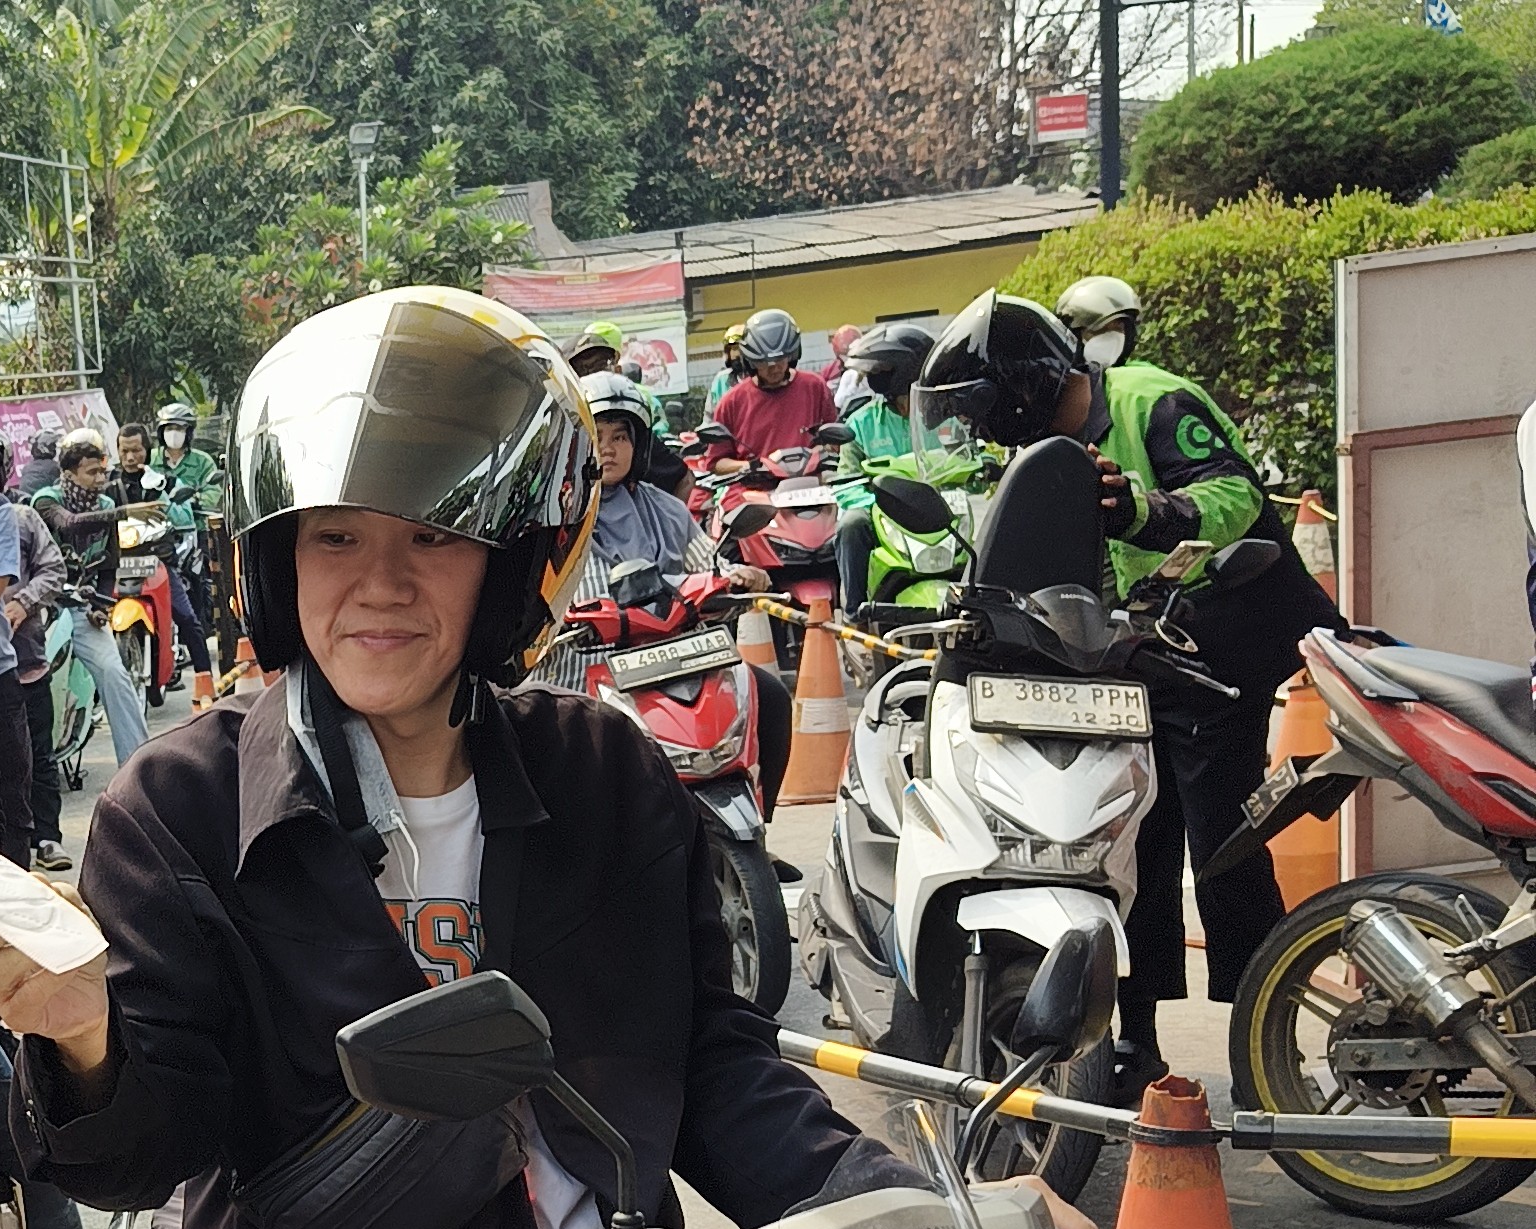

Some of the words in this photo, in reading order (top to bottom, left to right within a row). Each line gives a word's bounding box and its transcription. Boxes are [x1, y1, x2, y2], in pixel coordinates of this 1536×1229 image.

[617, 658, 629, 672] B
[638, 646, 678, 667] 4988
[981, 680, 995, 699] B
[1014, 682, 1078, 705] 3882
[1091, 687, 1141, 709] PPM
